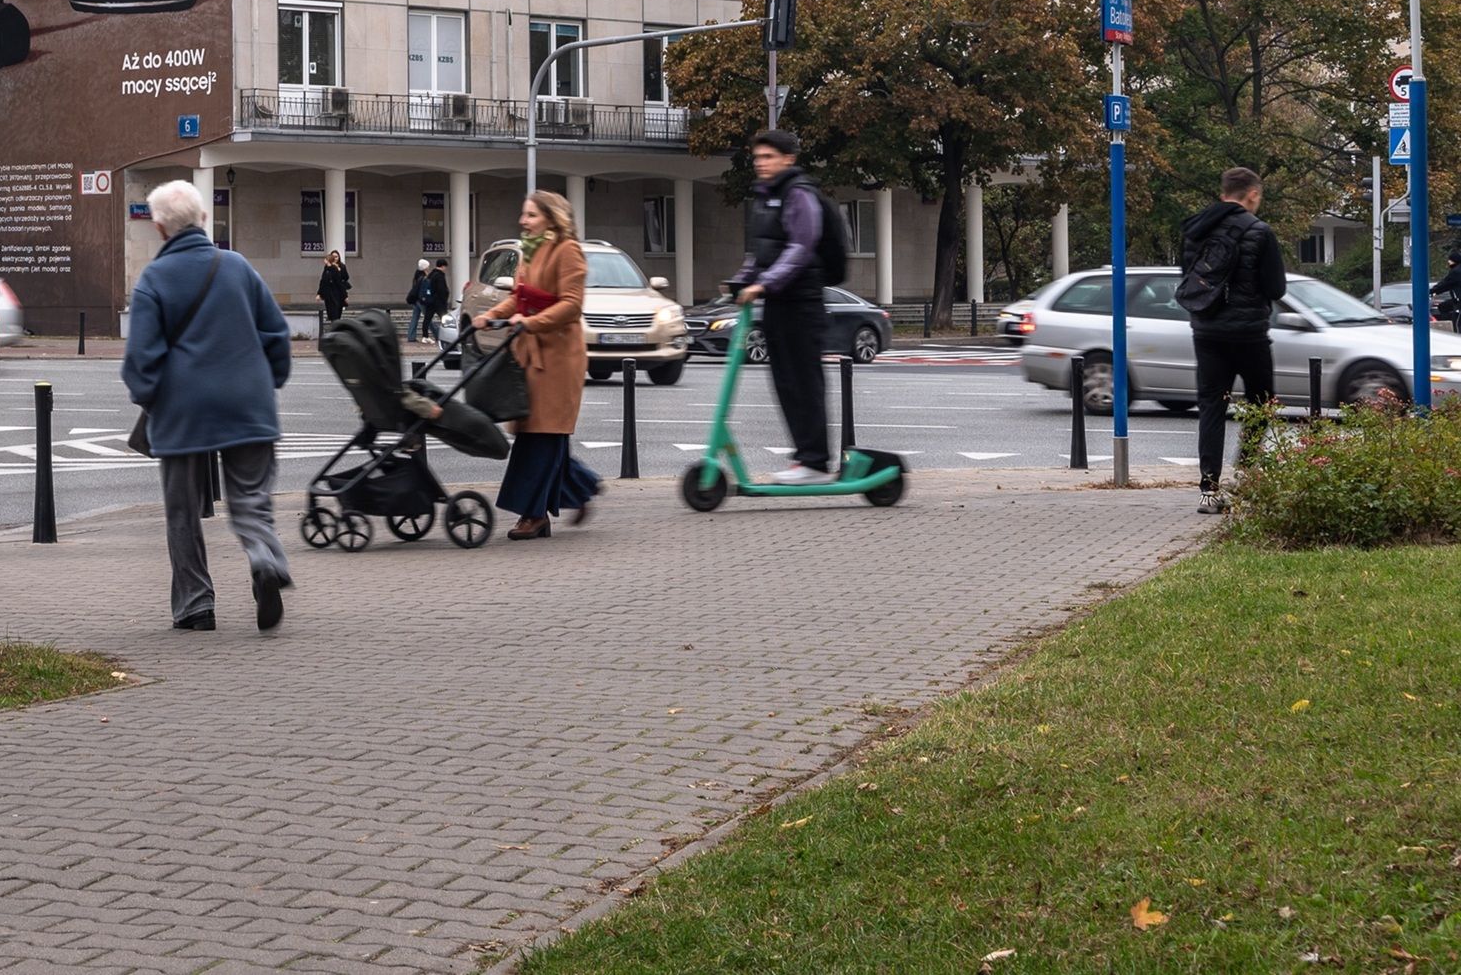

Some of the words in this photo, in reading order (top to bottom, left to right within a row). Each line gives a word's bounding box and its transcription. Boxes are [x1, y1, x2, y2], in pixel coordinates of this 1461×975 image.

[122, 53, 140, 70] Aż
[142, 52, 162, 69] do
[165, 48, 205, 68] 400W
[122, 78, 162, 98] mocy
[1400, 86, 1407, 96] 5
[184, 120, 190, 132] 6
